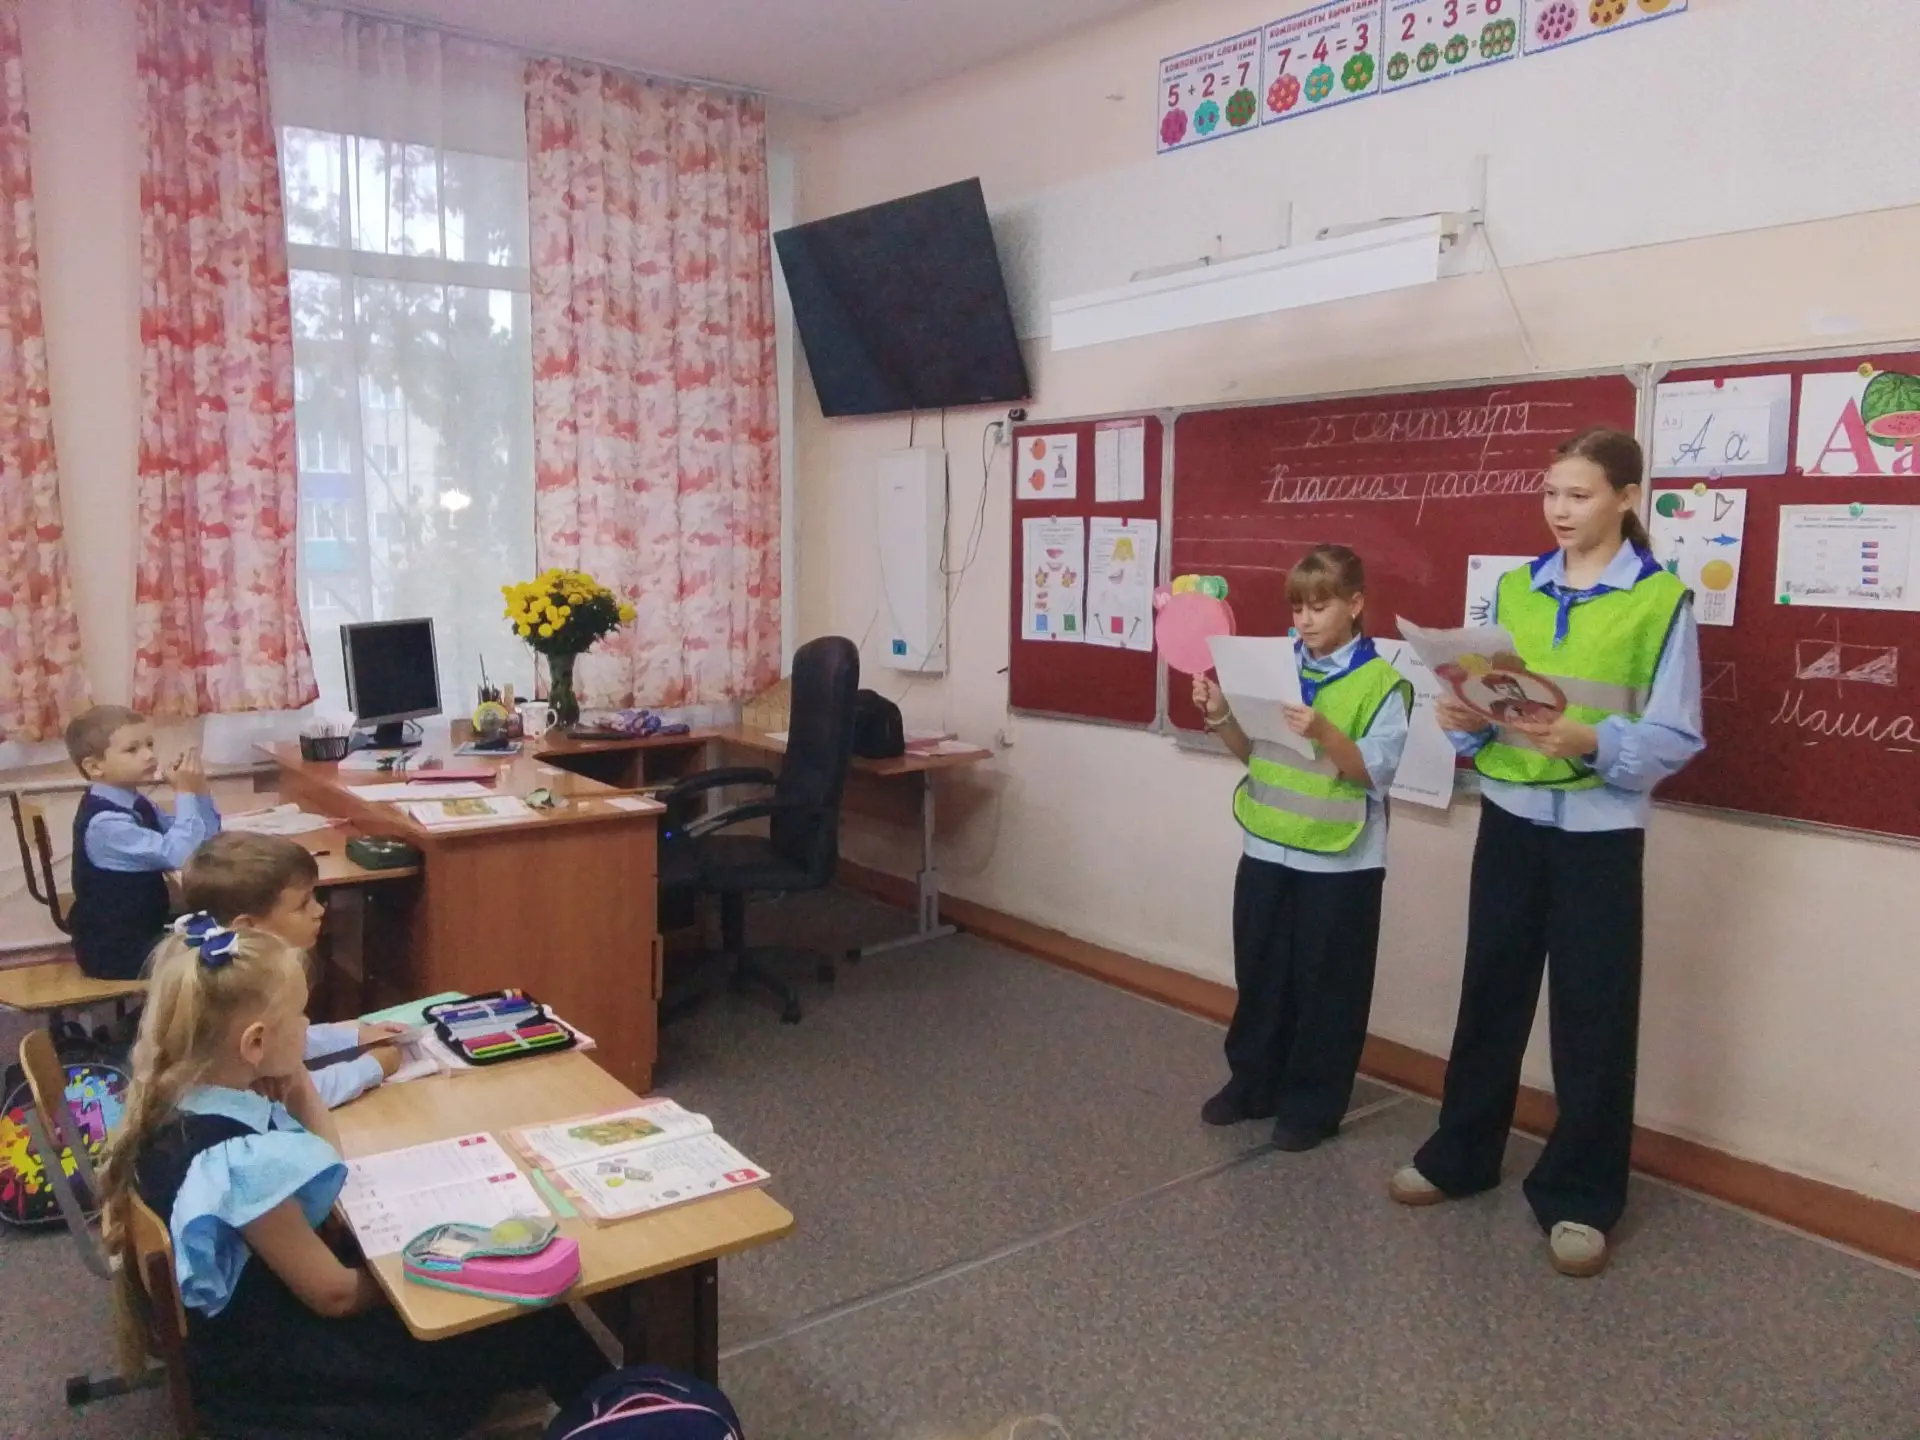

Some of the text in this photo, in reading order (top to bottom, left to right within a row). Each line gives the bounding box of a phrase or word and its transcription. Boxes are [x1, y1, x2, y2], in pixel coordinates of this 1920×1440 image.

[1269, 12, 1326, 38] КОМПОНЕНТЫ
[1401, 12, 1416, 41] 2
[1442, 0, 1458, 28] 3
[1466, 3, 1477, 14] =
[1165, 51, 1214, 73] КОМПОНЕНТЫ
[1278, 48, 1292, 75] 7
[1312, 35, 1328, 62] 4
[1335, 39, 1348, 51] =
[1353, 23, 1369, 51] 3
[1168, 83, 1179, 107] 5
[1188, 84, 1195, 95] +
[1202, 72, 1215, 98] 2
[1221, 75, 1230, 86] =
[1237, 61, 1250, 86] 7
[1268, 463, 1548, 525] Классная работа
